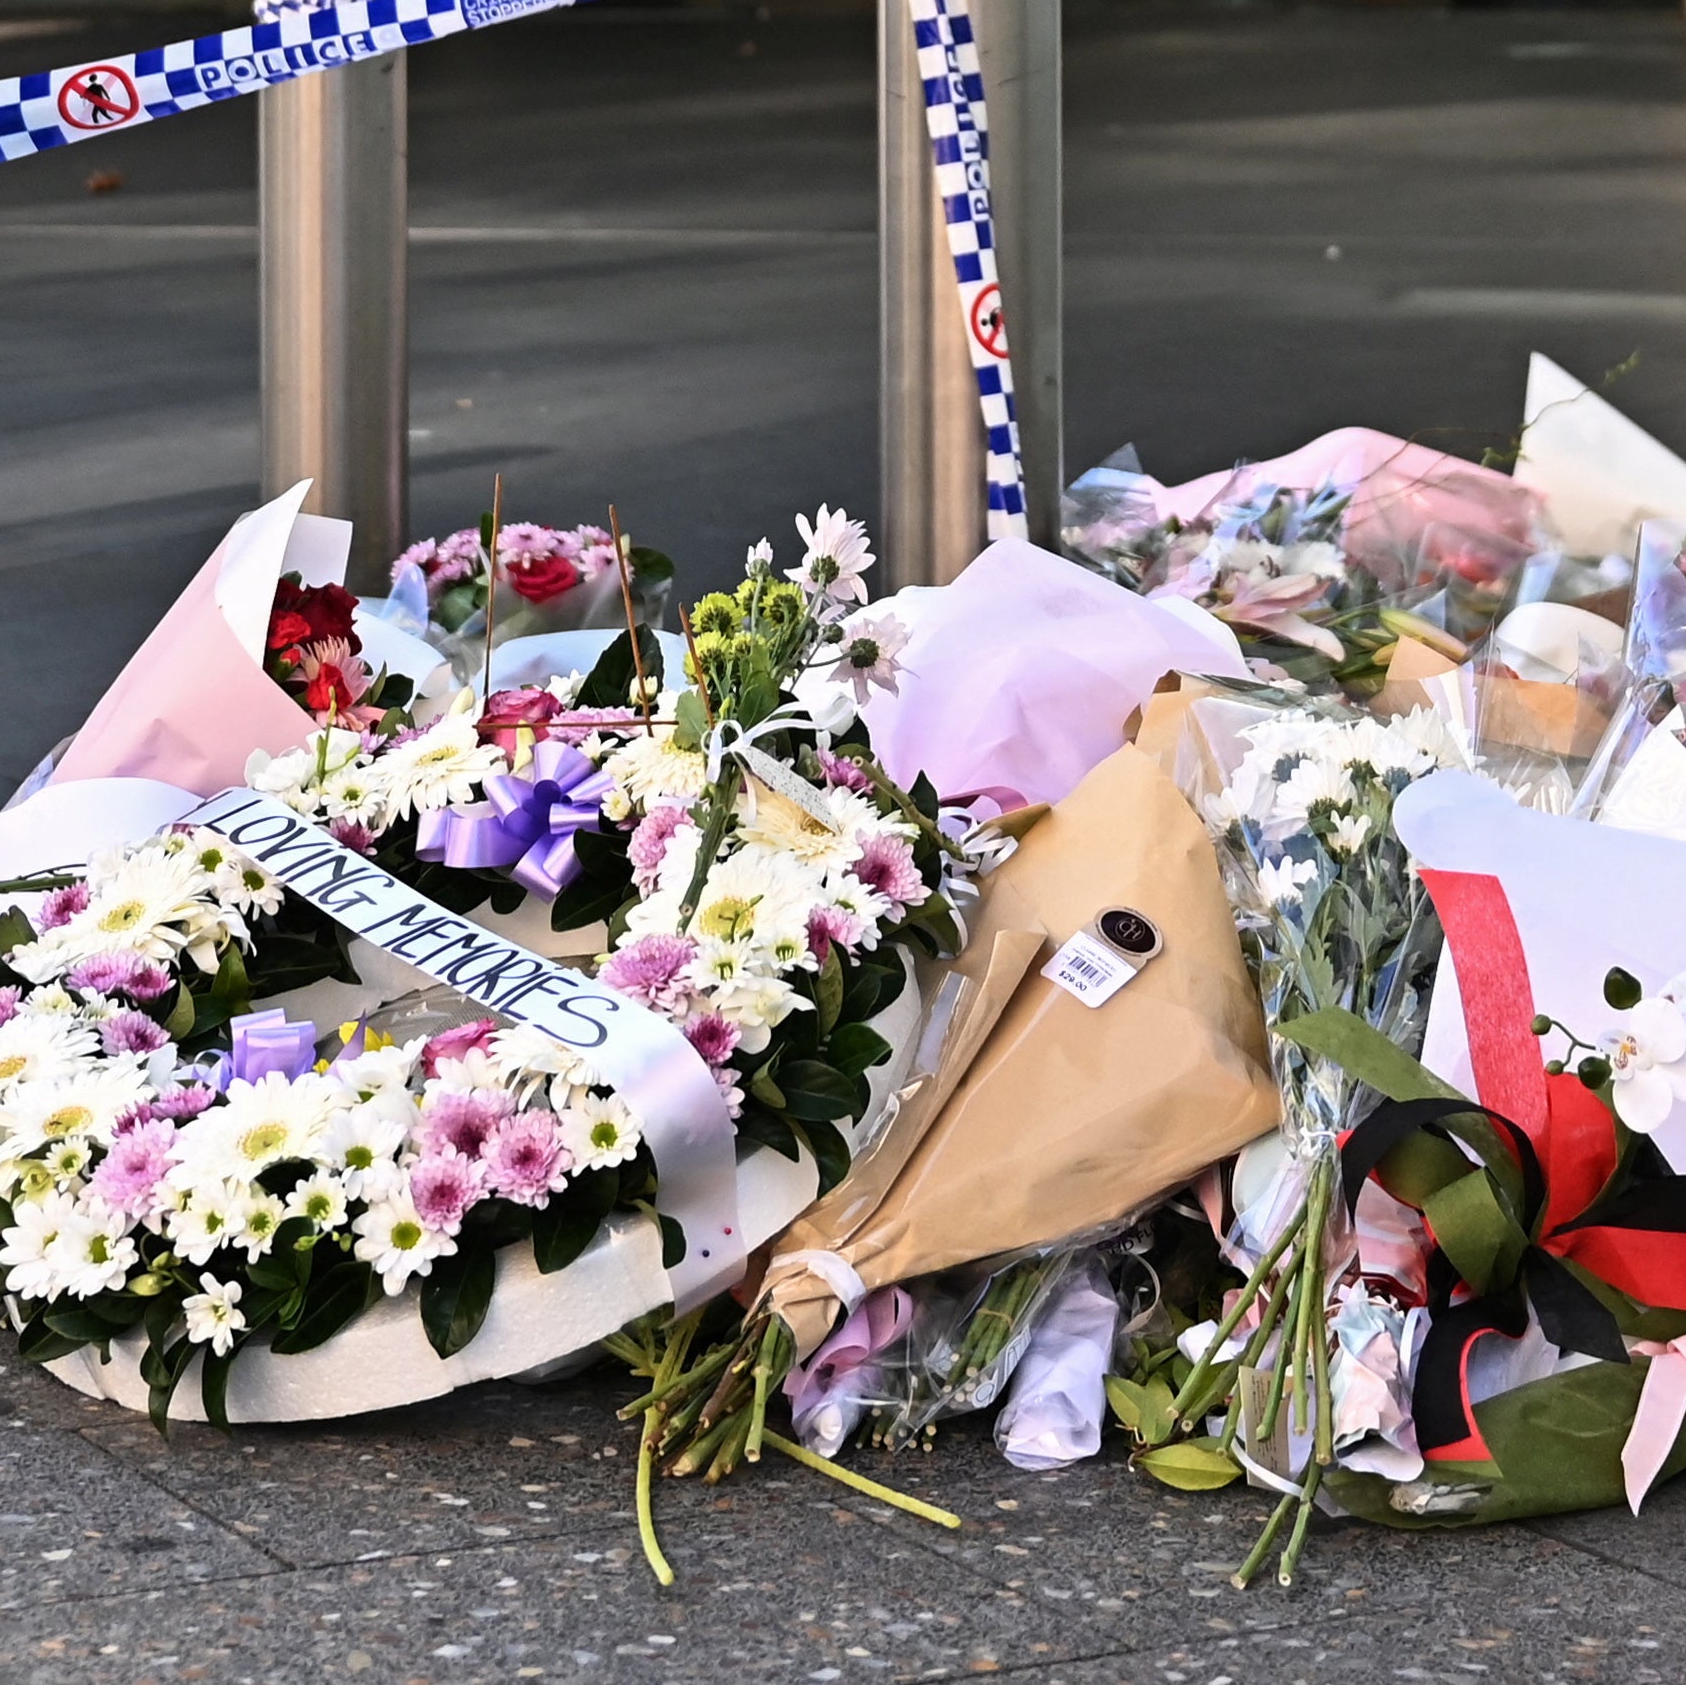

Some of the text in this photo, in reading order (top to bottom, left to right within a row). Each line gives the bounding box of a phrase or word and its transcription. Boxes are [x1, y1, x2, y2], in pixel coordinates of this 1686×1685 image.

[201, 33, 370, 89] POLICE
[203, 799, 620, 1048] LOVING MEMORIES
